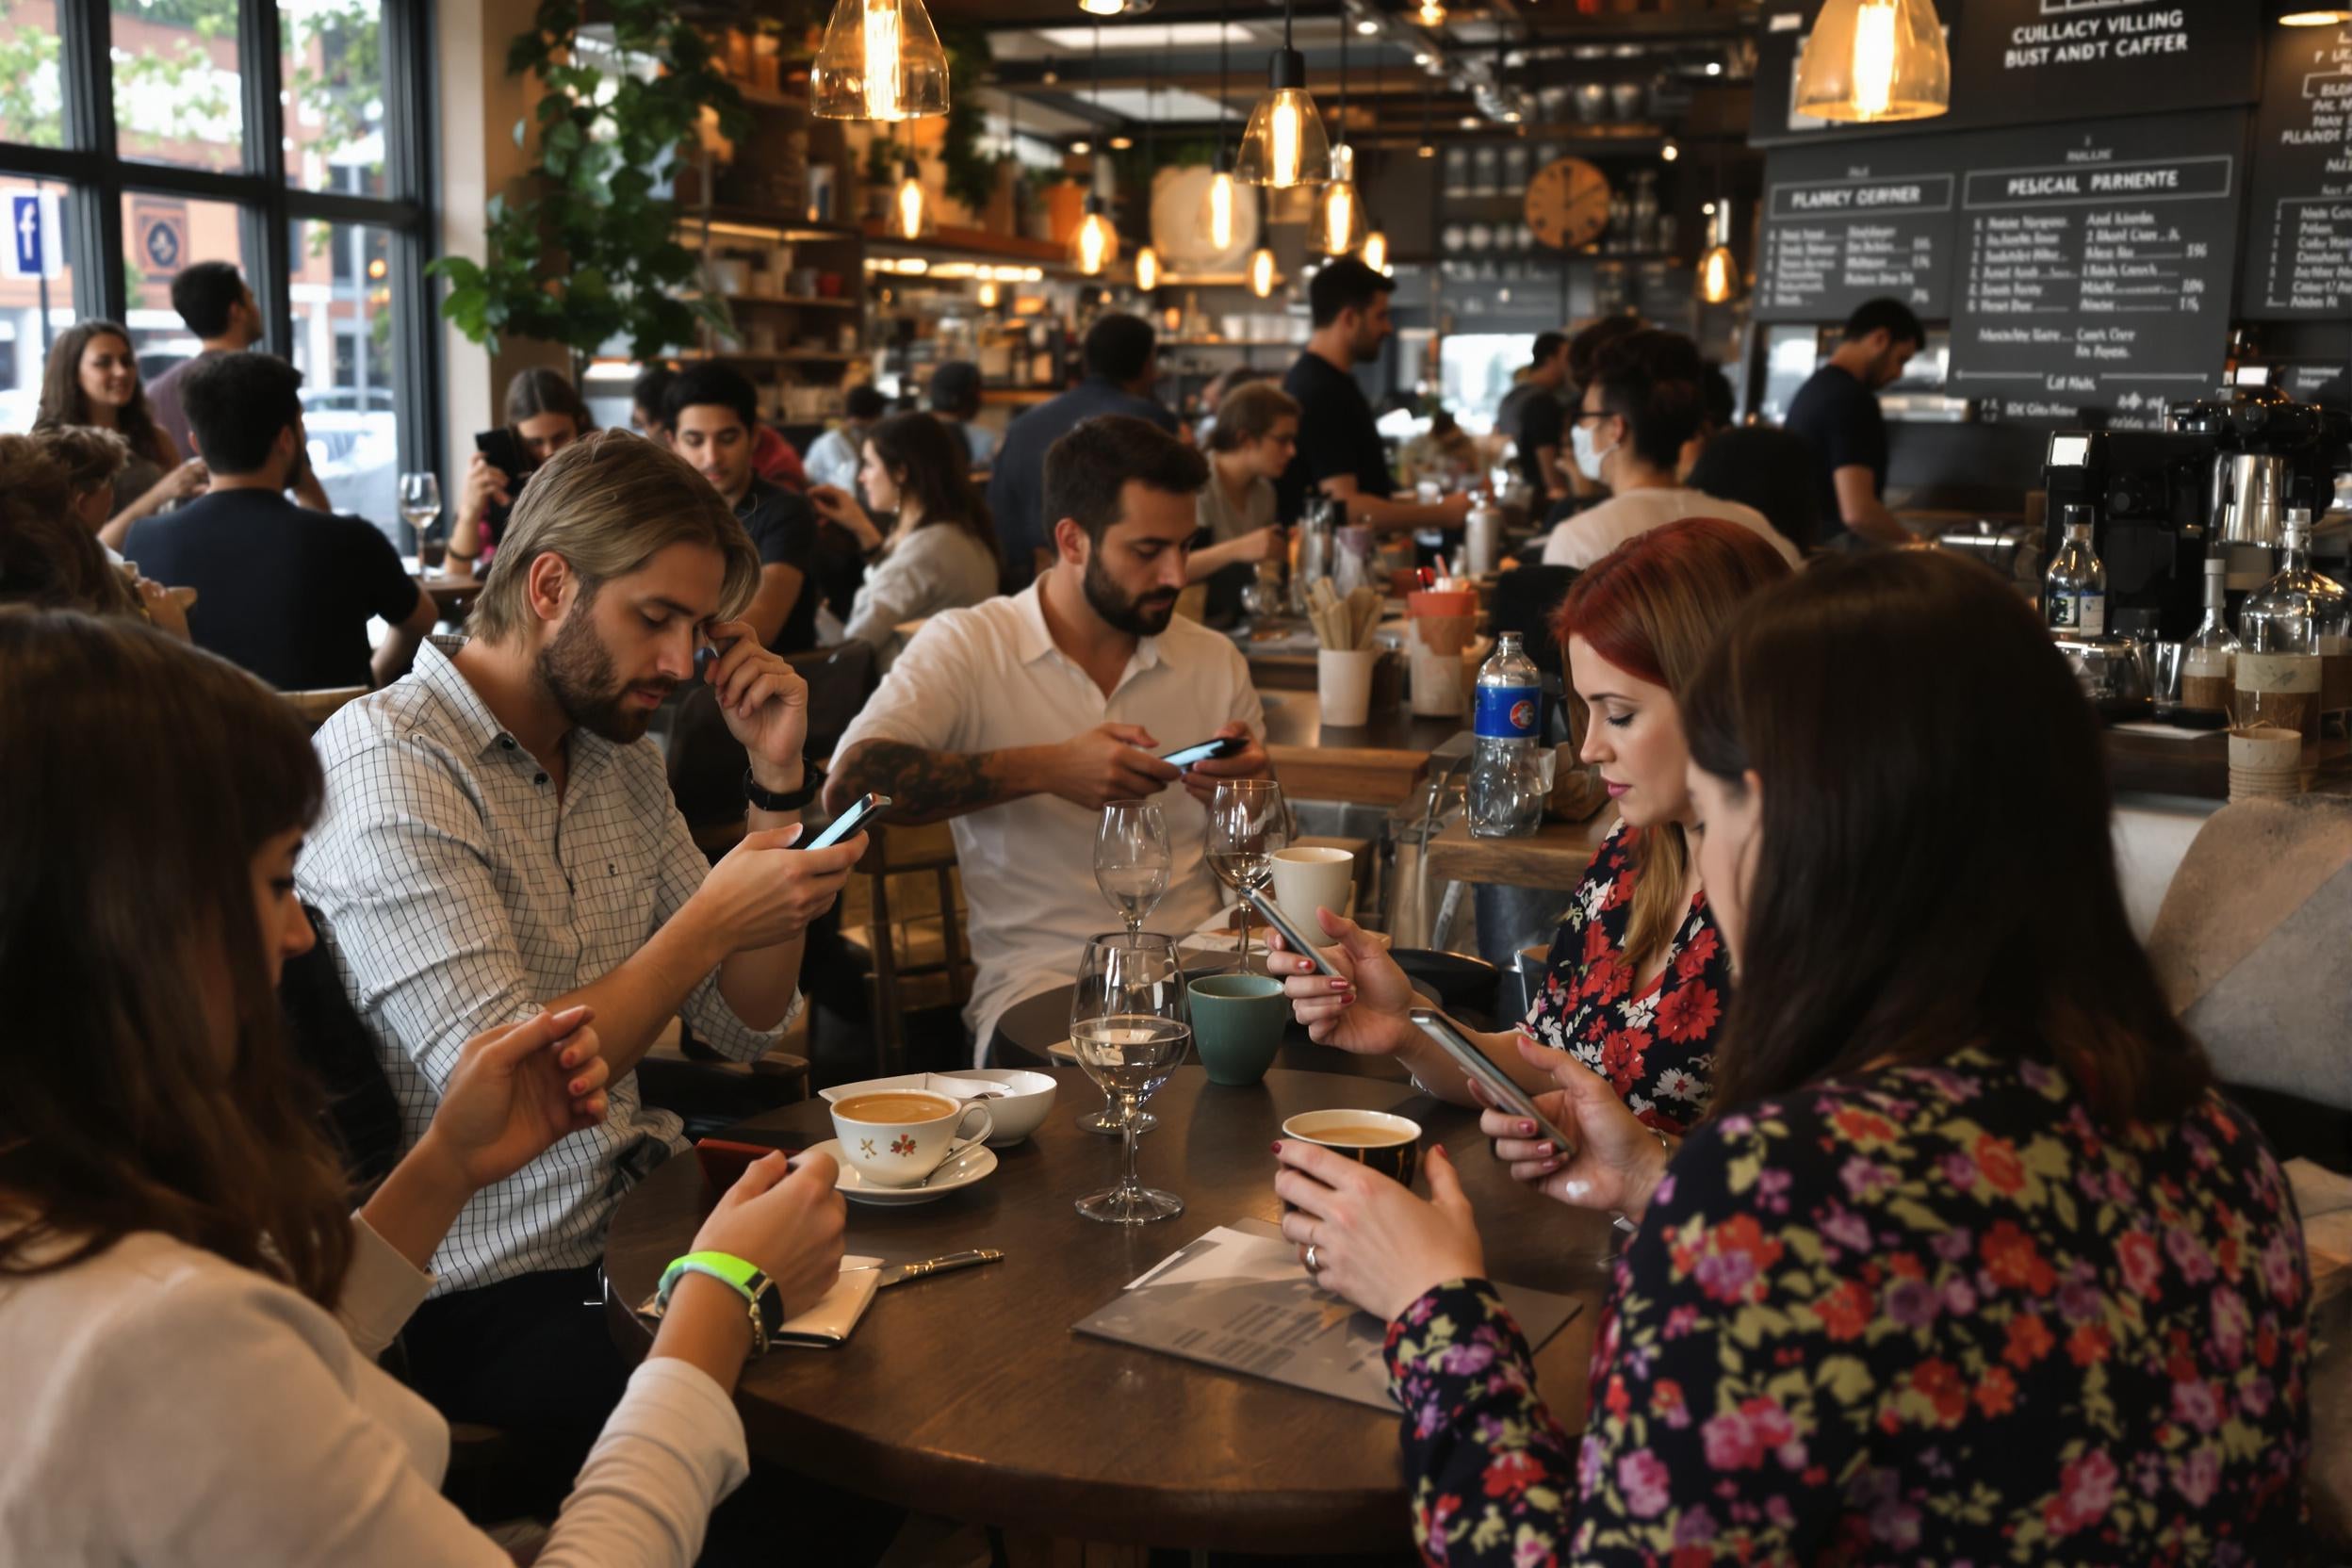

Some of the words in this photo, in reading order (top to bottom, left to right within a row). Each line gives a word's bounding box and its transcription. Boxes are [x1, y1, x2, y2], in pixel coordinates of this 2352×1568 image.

[2107, 9, 2183, 34] VILLING
[2004, 48, 2050, 69] BUST
[2115, 33, 2188, 57] CAFFER
